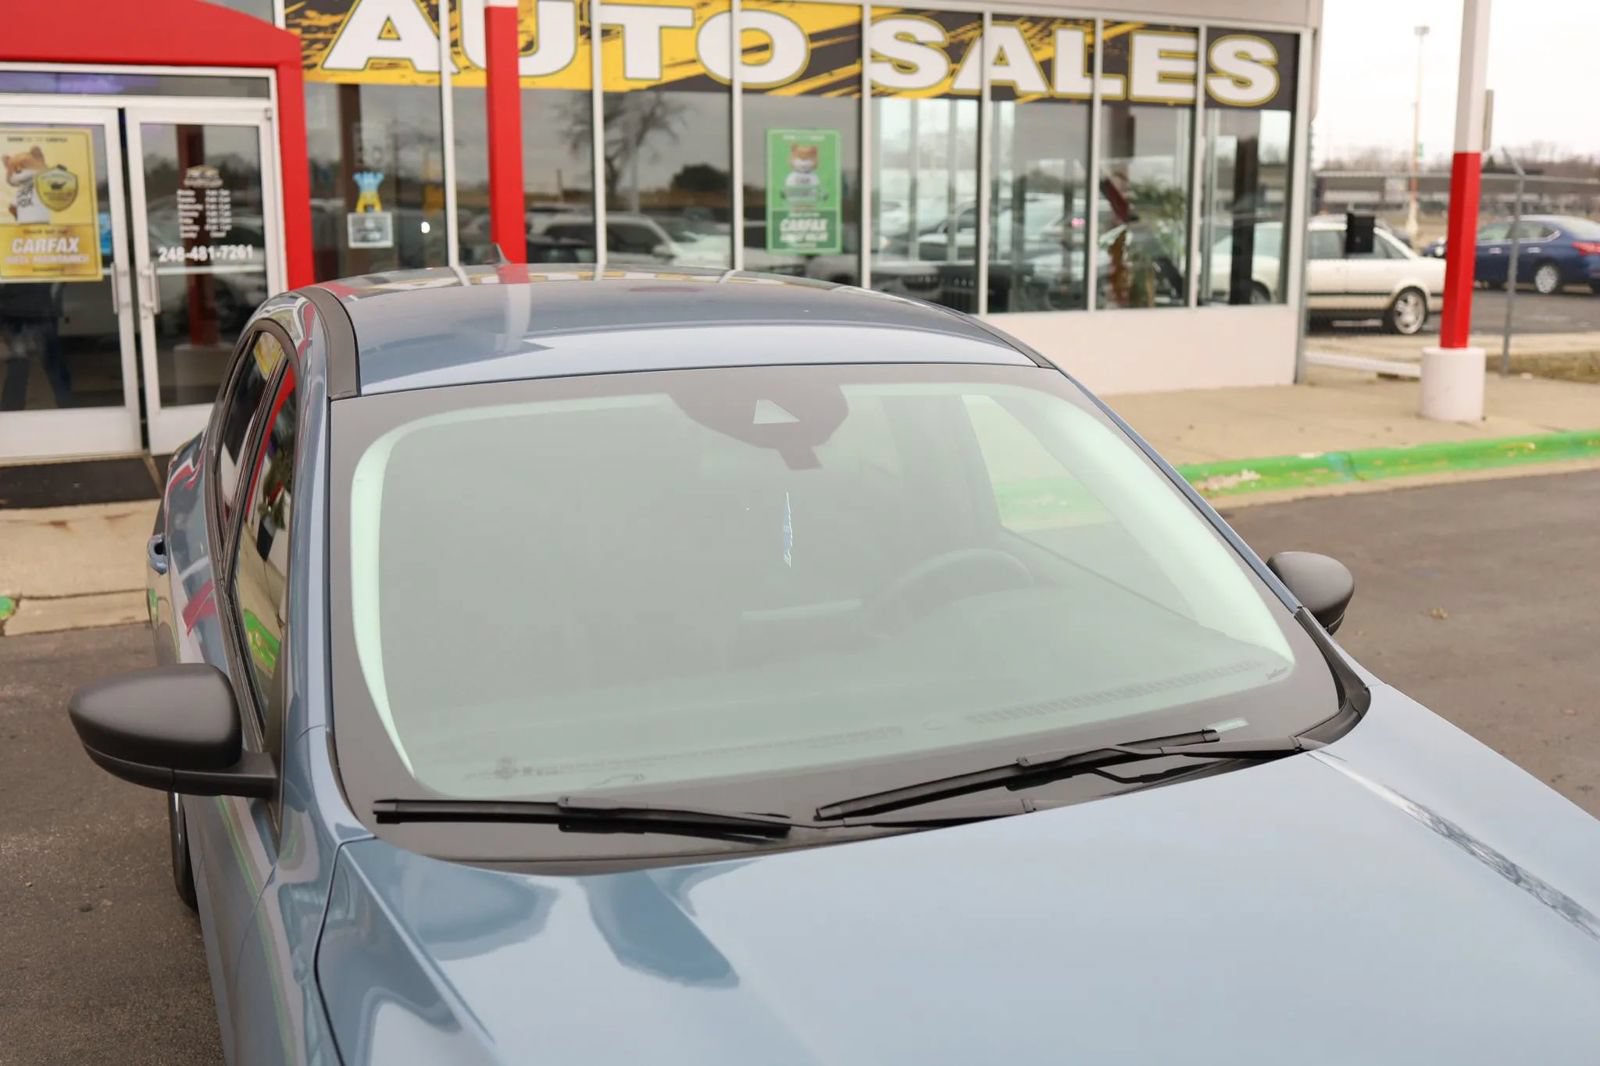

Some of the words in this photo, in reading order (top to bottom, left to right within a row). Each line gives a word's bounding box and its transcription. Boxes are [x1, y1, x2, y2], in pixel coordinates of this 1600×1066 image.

[321, 0, 809, 88] AUTO
[868, 15, 1280, 107] SALES
[12, 237, 80, 254] CARFAX
